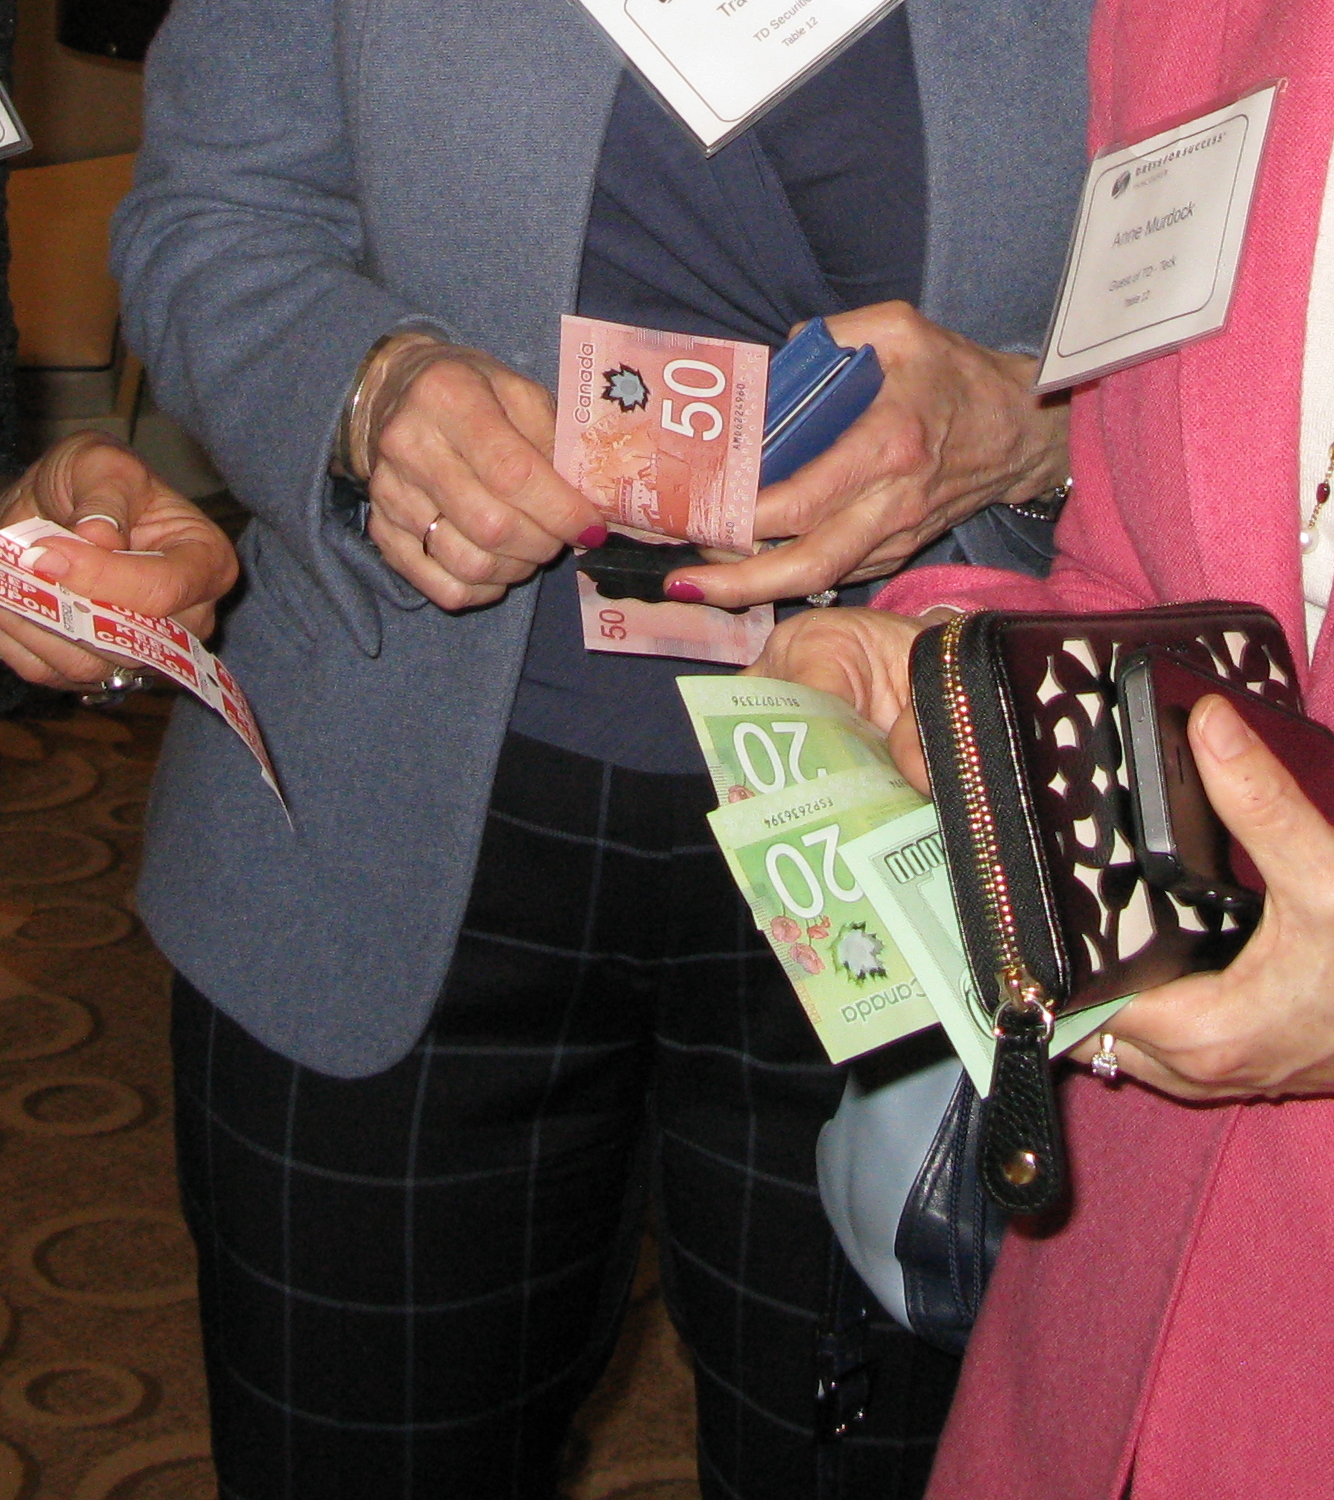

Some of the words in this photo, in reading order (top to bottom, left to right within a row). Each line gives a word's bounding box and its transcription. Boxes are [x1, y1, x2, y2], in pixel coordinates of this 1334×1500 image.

[753, 26, 770, 43] TD
[782, 26, 806, 47] Table
[805, 16, 818, 28] 12
[1112, 223, 1142, 247] Anne
[1144, 201, 1195, 237] Murdock
[575, 343, 594, 424] Canada
[661, 359, 726, 441] 50
[116, 623, 179, 658] KEEP
[599, 609, 627, 640] 50
[96, 631, 198, 686] COUPON
[734, 722, 827, 794] 20
[766, 824, 865, 919] 20
